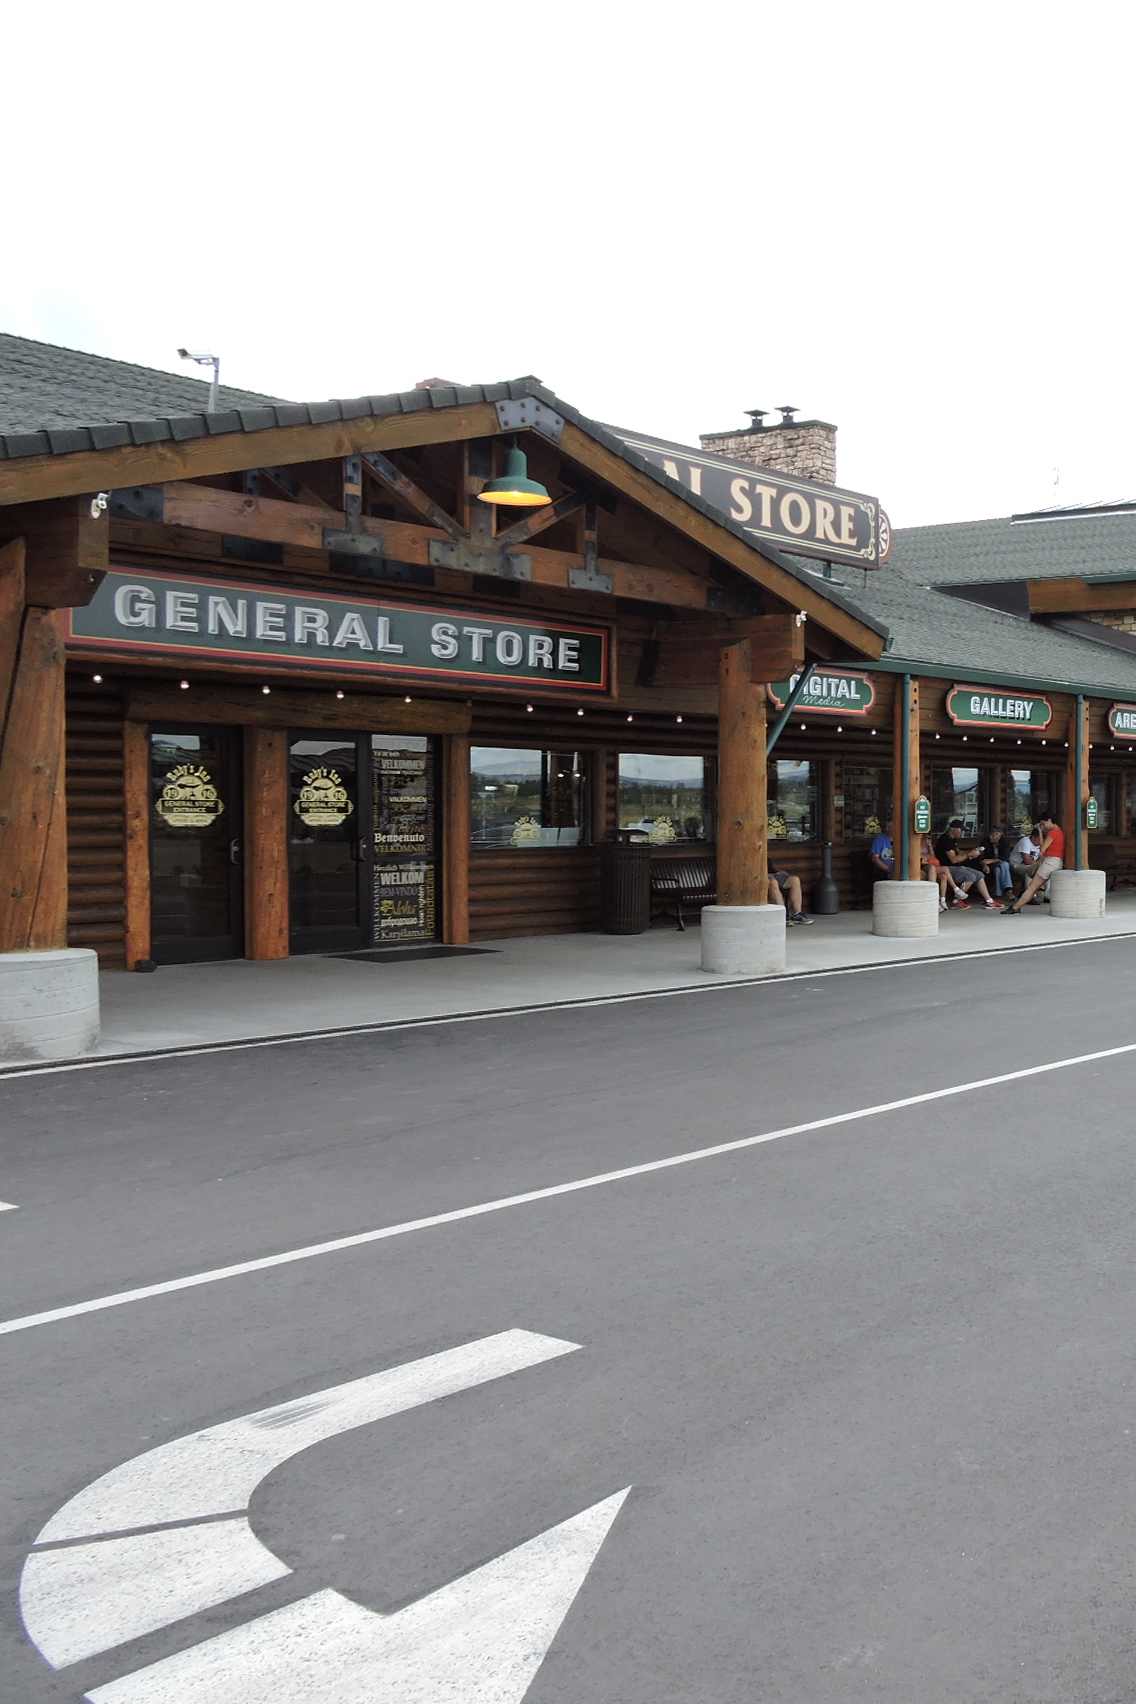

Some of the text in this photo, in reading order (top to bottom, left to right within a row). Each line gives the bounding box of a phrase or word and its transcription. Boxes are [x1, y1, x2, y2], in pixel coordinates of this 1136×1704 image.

[730, 479, 857, 545] STORE
[114, 585, 581, 672] GENERAL STORE
[970, 696, 1034, 720] GALLERY
[380, 871, 425, 885] WELKOM
